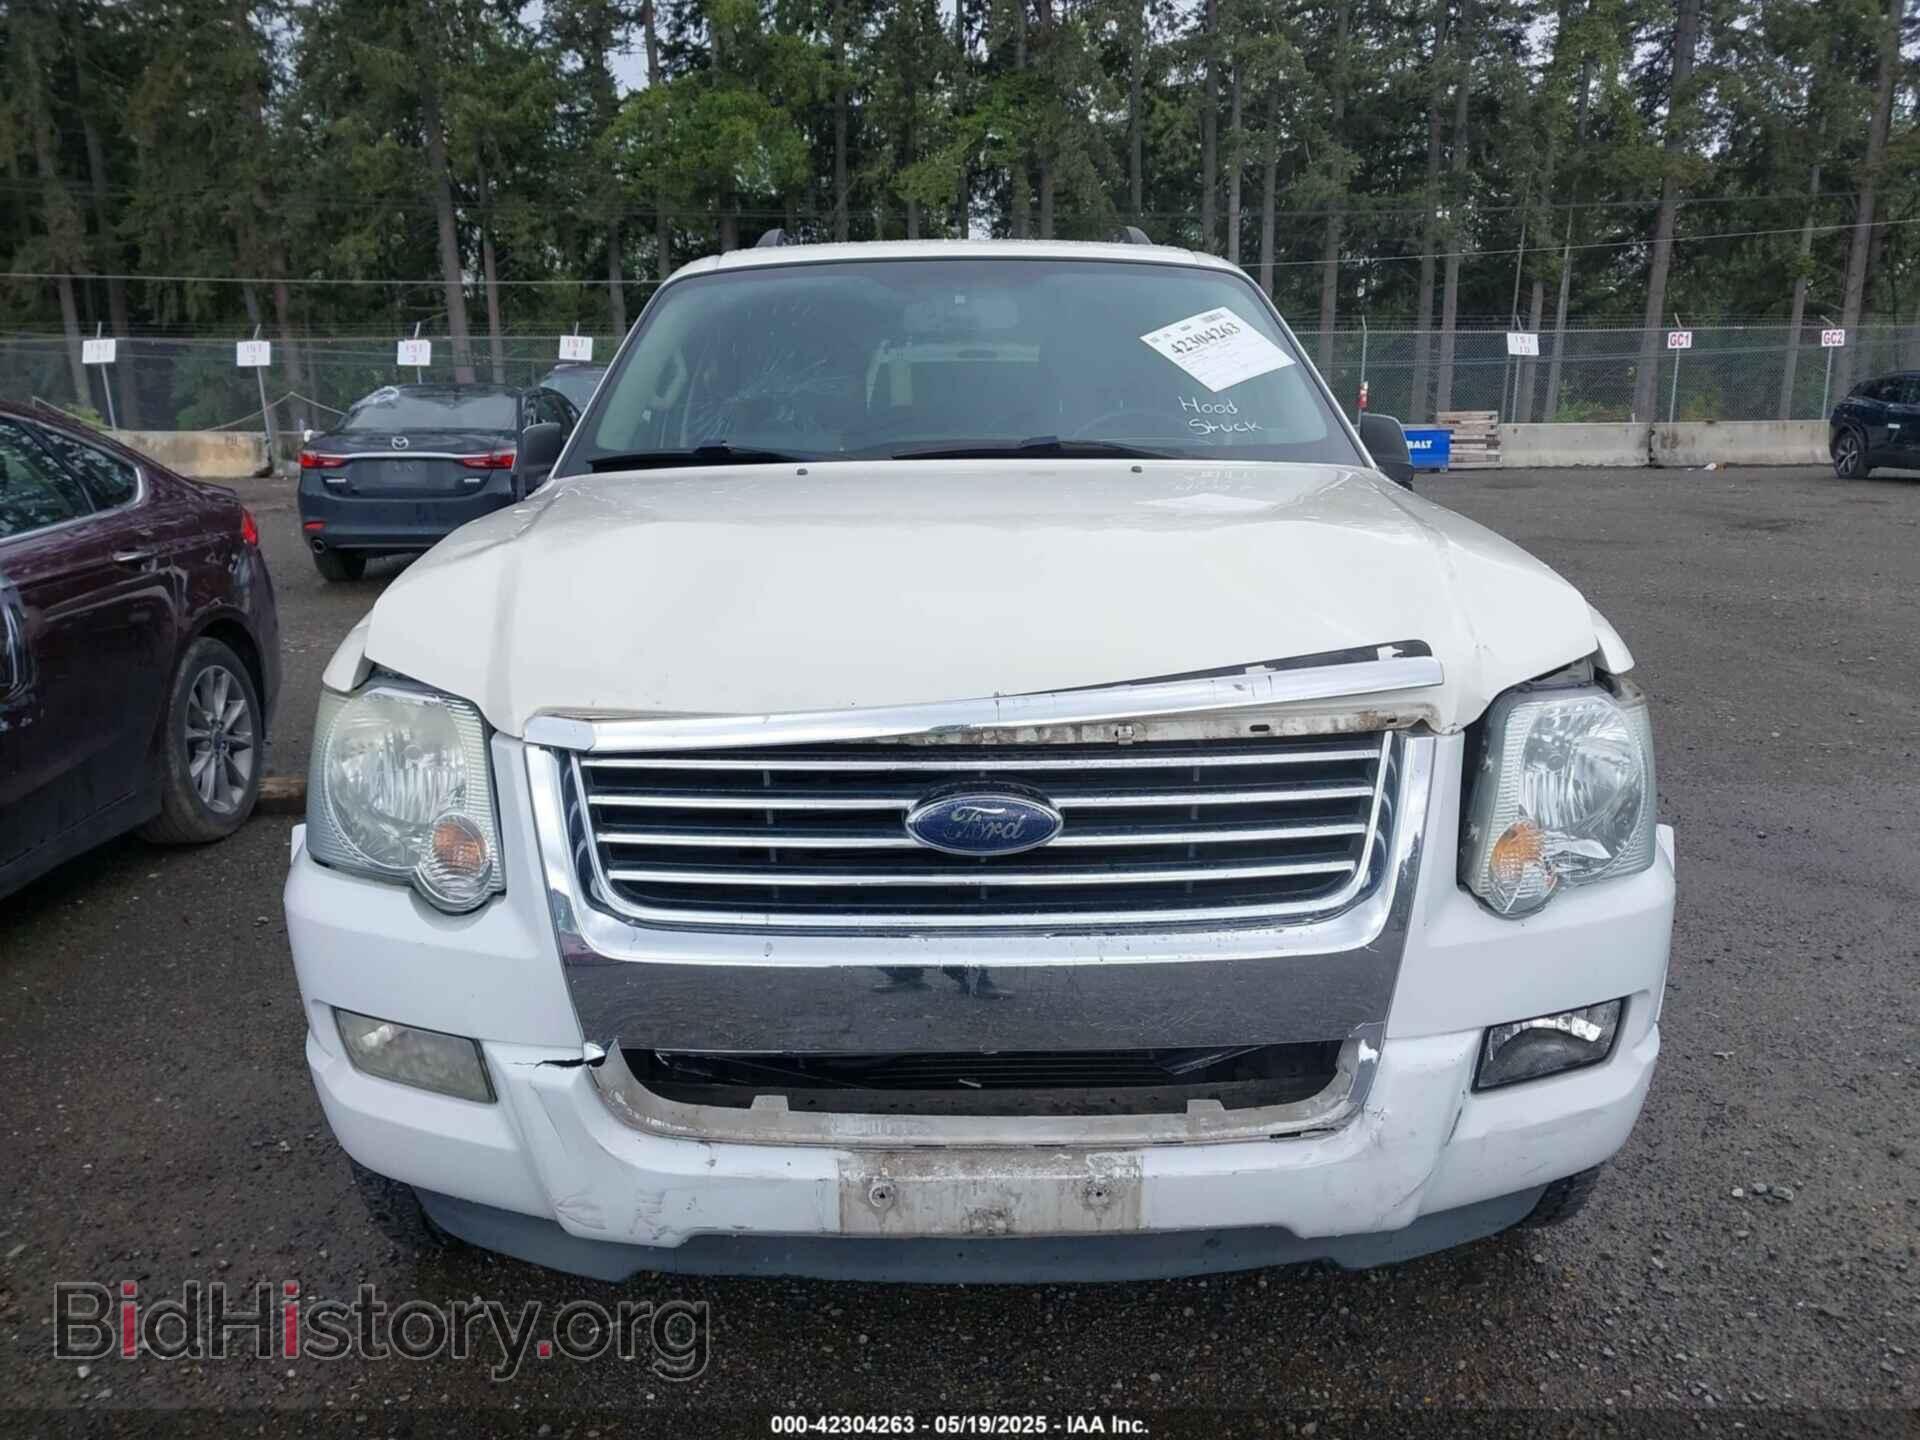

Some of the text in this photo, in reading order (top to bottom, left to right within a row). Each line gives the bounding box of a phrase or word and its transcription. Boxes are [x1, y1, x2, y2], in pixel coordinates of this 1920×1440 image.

[1170, 322, 1240, 353] 42304263
[1670, 333, 1689, 346] GC1
[1824, 331, 1842, 345] GC2
[1178, 396, 1238, 414] Hood
[1188, 418, 1263, 435] Stuck
[944, 806, 1026, 840] Ford
